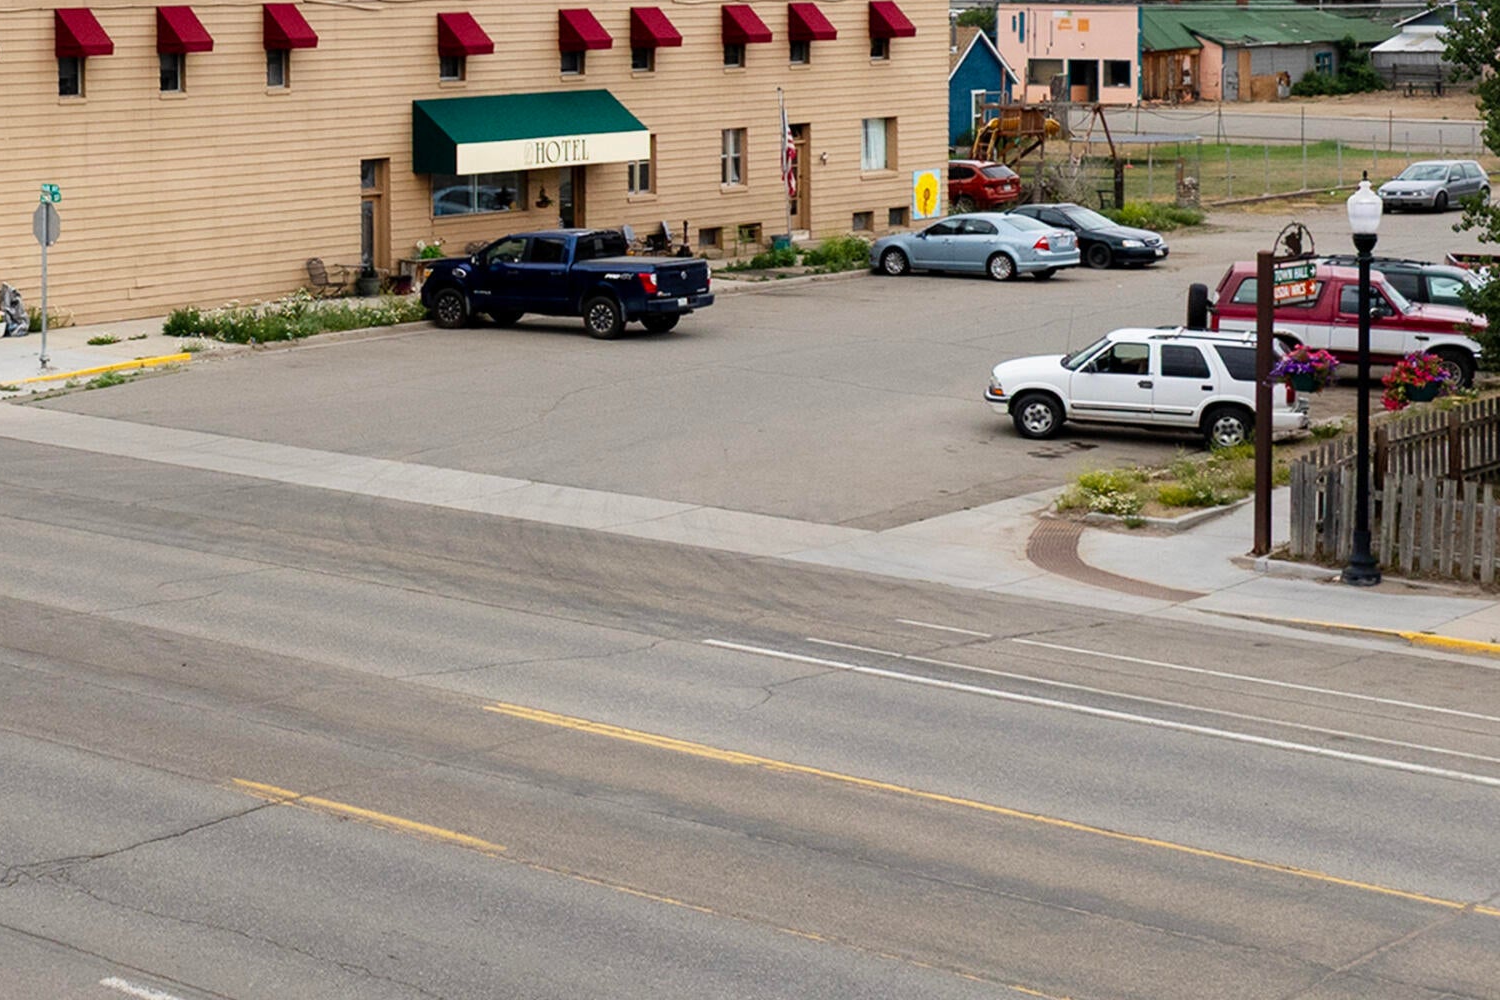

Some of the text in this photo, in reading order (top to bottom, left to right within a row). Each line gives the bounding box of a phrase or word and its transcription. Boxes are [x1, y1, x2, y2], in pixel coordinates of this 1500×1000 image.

[535, 139, 589, 164] HOTEL
[1274, 266, 1308, 282] TOWN HALL
